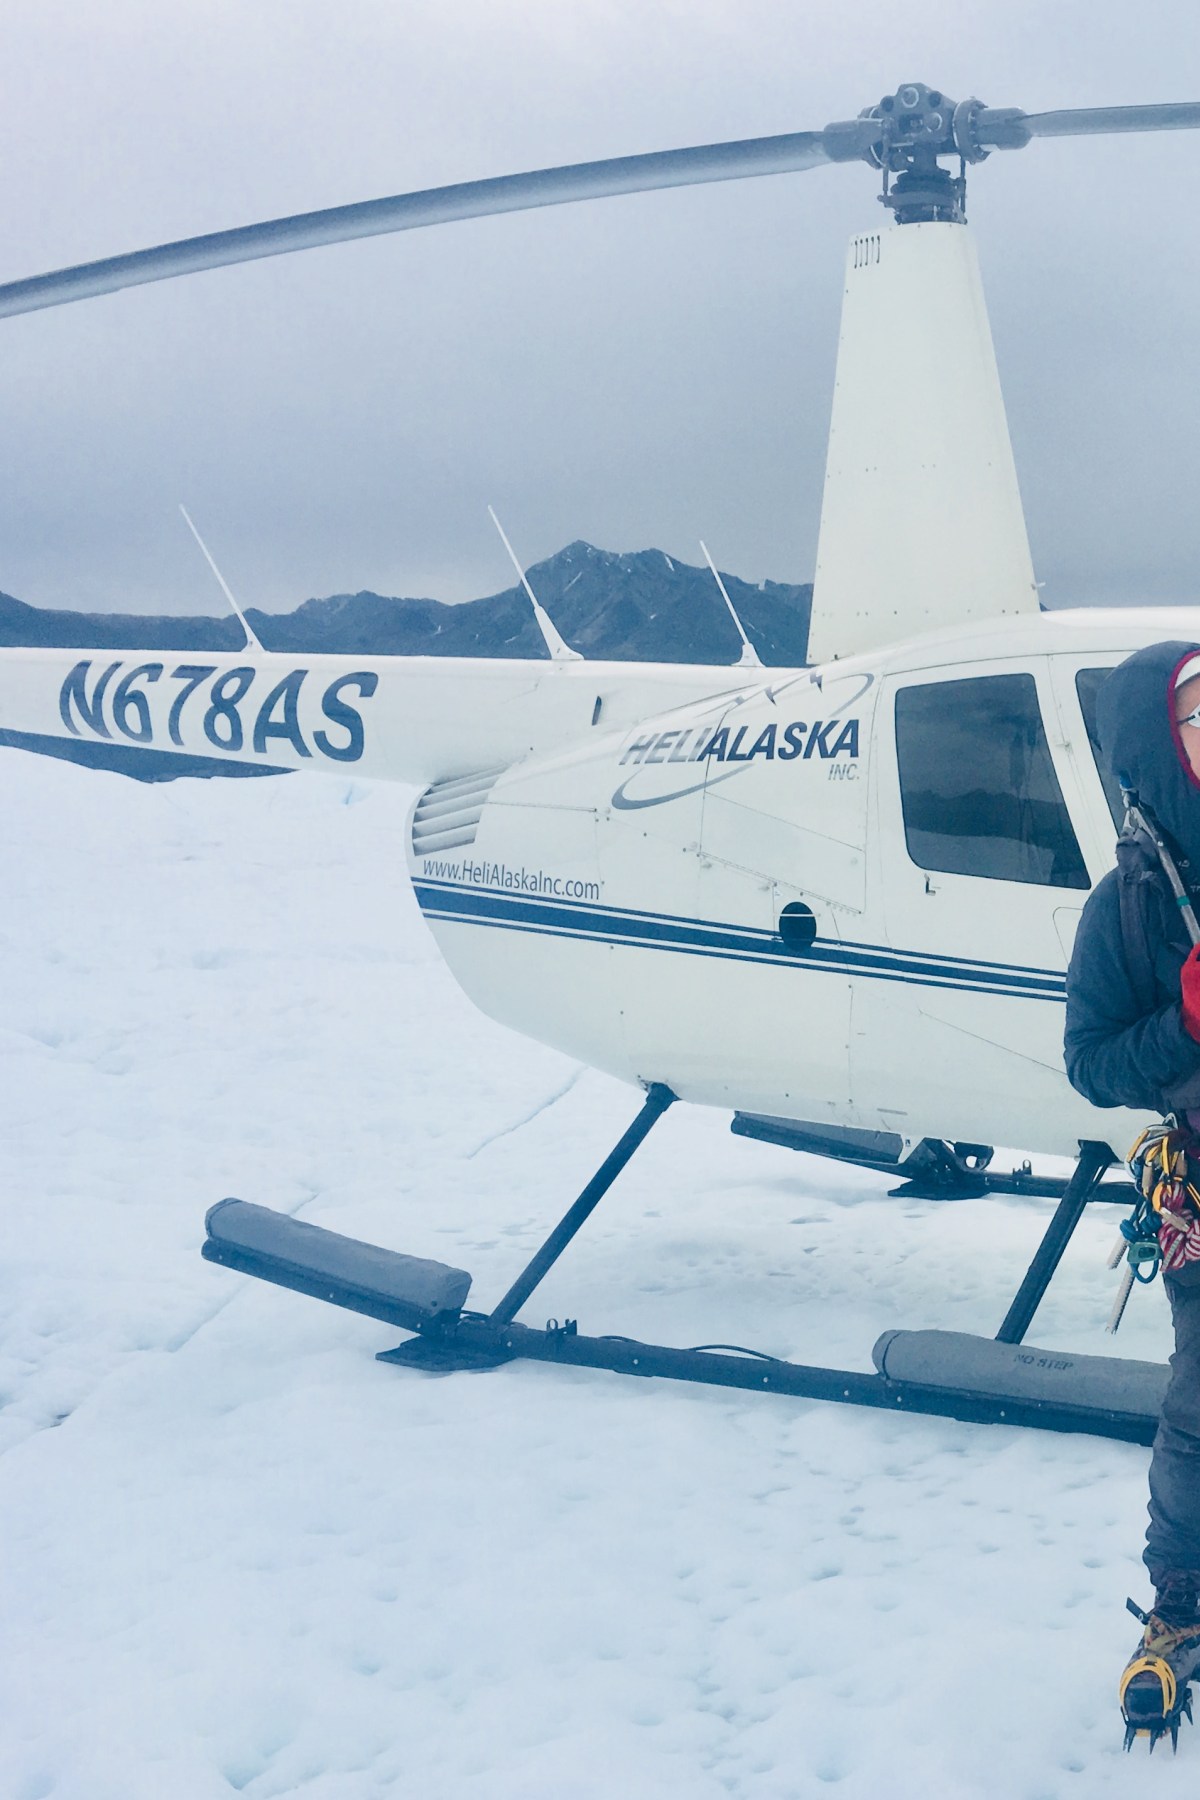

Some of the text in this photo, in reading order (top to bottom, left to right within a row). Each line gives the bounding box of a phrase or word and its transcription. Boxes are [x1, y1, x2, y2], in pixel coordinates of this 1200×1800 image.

[59, 660, 379, 762] N678AS
[828, 764, 860, 780] INC.
[423, 859, 600, 900] www.HeliAlaskaInc.com
[1013, 1354, 1075, 1370] NO STEP
